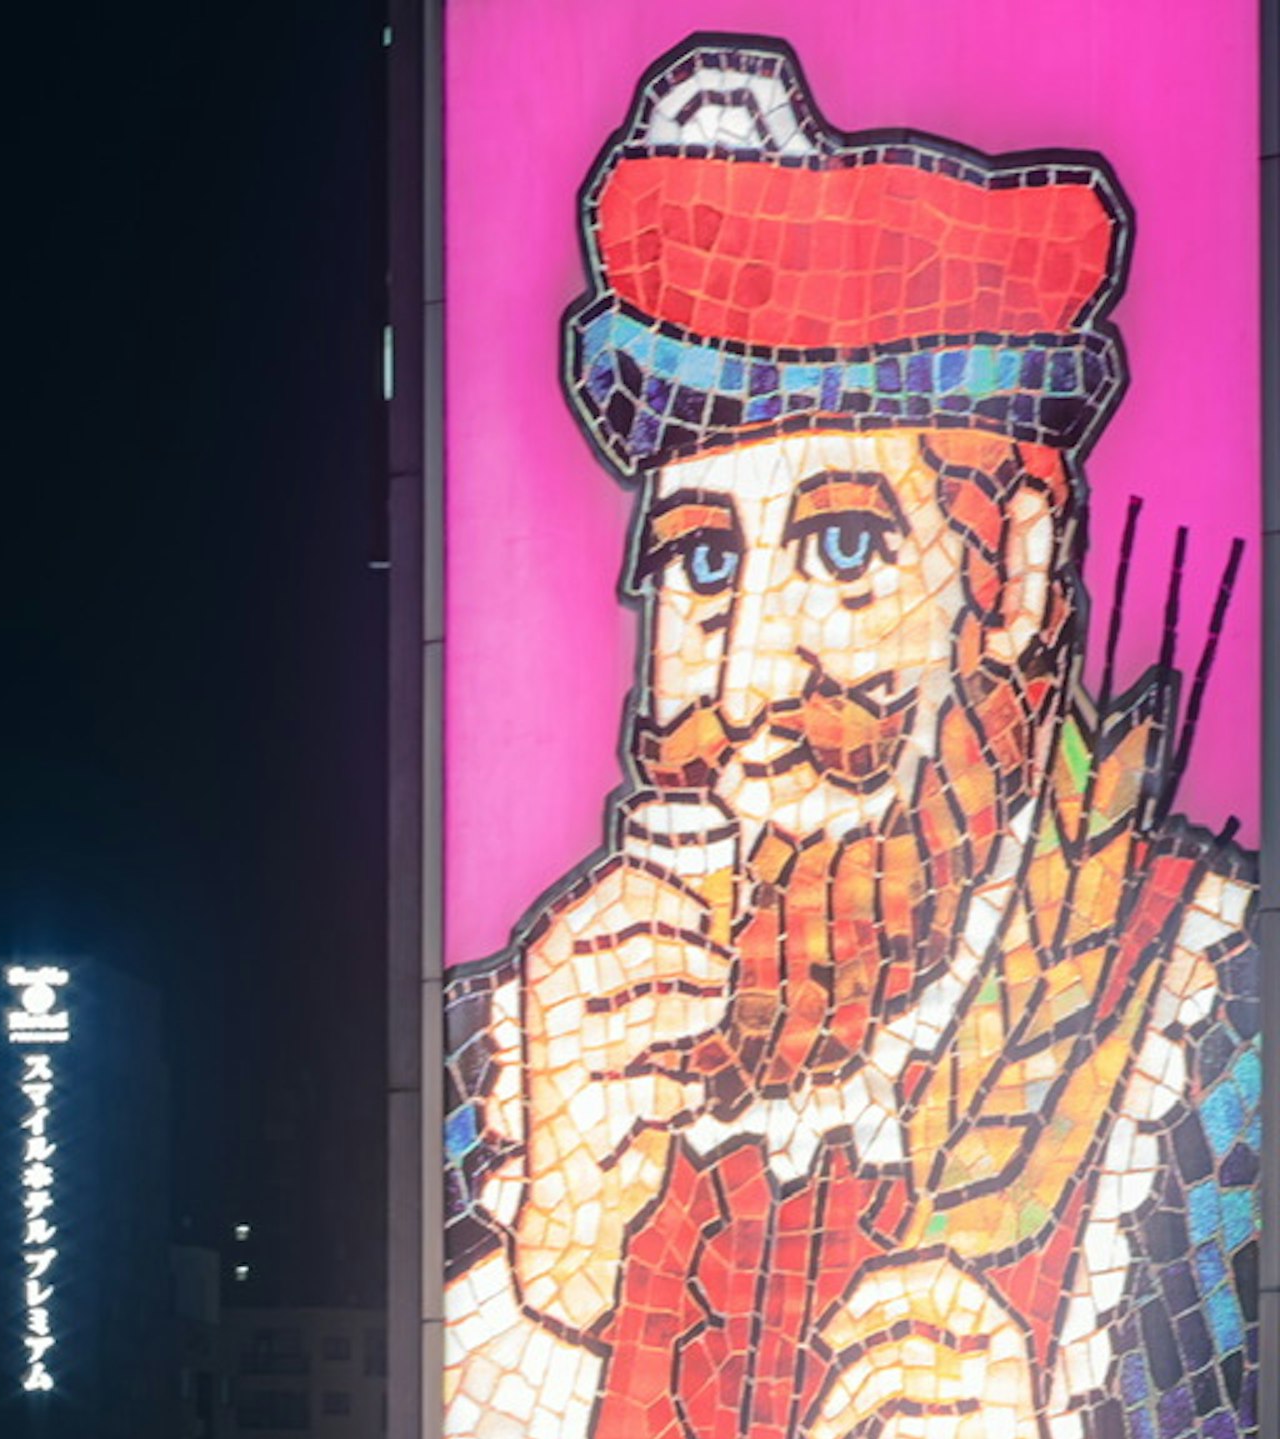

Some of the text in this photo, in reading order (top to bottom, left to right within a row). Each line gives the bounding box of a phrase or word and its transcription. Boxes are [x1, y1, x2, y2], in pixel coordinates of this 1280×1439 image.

[21, 1054, 56, 1392] スマイルホテルプレミアム
